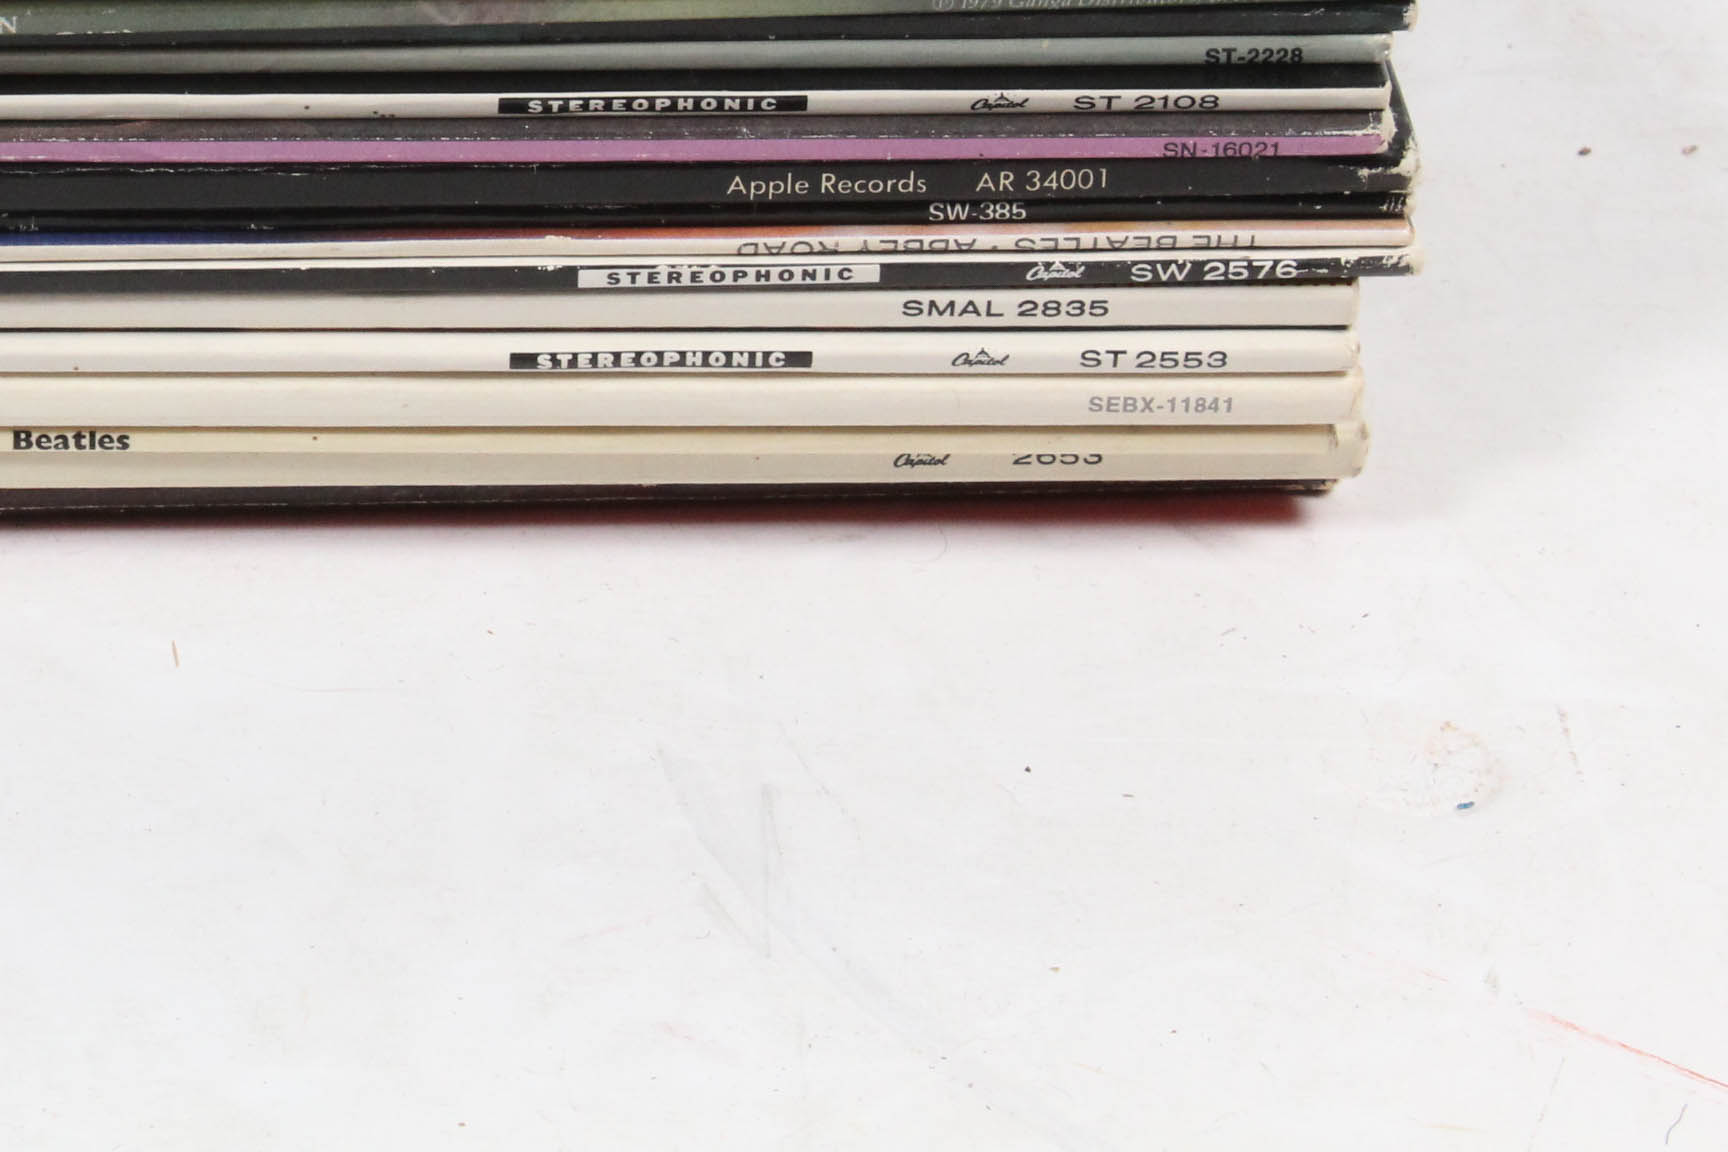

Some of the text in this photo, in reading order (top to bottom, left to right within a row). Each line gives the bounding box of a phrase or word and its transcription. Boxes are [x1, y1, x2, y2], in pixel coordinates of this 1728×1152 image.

[1203, 47, 1304, 64] ST-2228
[526, 98, 777, 114] STEREOPHONIC
[1072, 95, 1122, 111] ST
[1133, 95, 1221, 111] 2108
[1162, 141, 1281, 158] SN-16021
[726, 168, 1109, 200] Apple Records AR 34001
[928, 202, 1027, 221] SW-385
[606, 267, 855, 285] STEREOPHONIC
[1130, 263, 1191, 281] SW
[1203, 260, 1299, 280] 2576
[901, 299, 1110, 316] SMAL 2835
[537, 352, 786, 368] STEREOPHONIC
[1079, 350, 1128, 367] ST
[1135, 350, 1228, 368] 2553
[1087, 396, 1234, 414] SEBX-11841
[12, 429, 130, 451] Beatles
